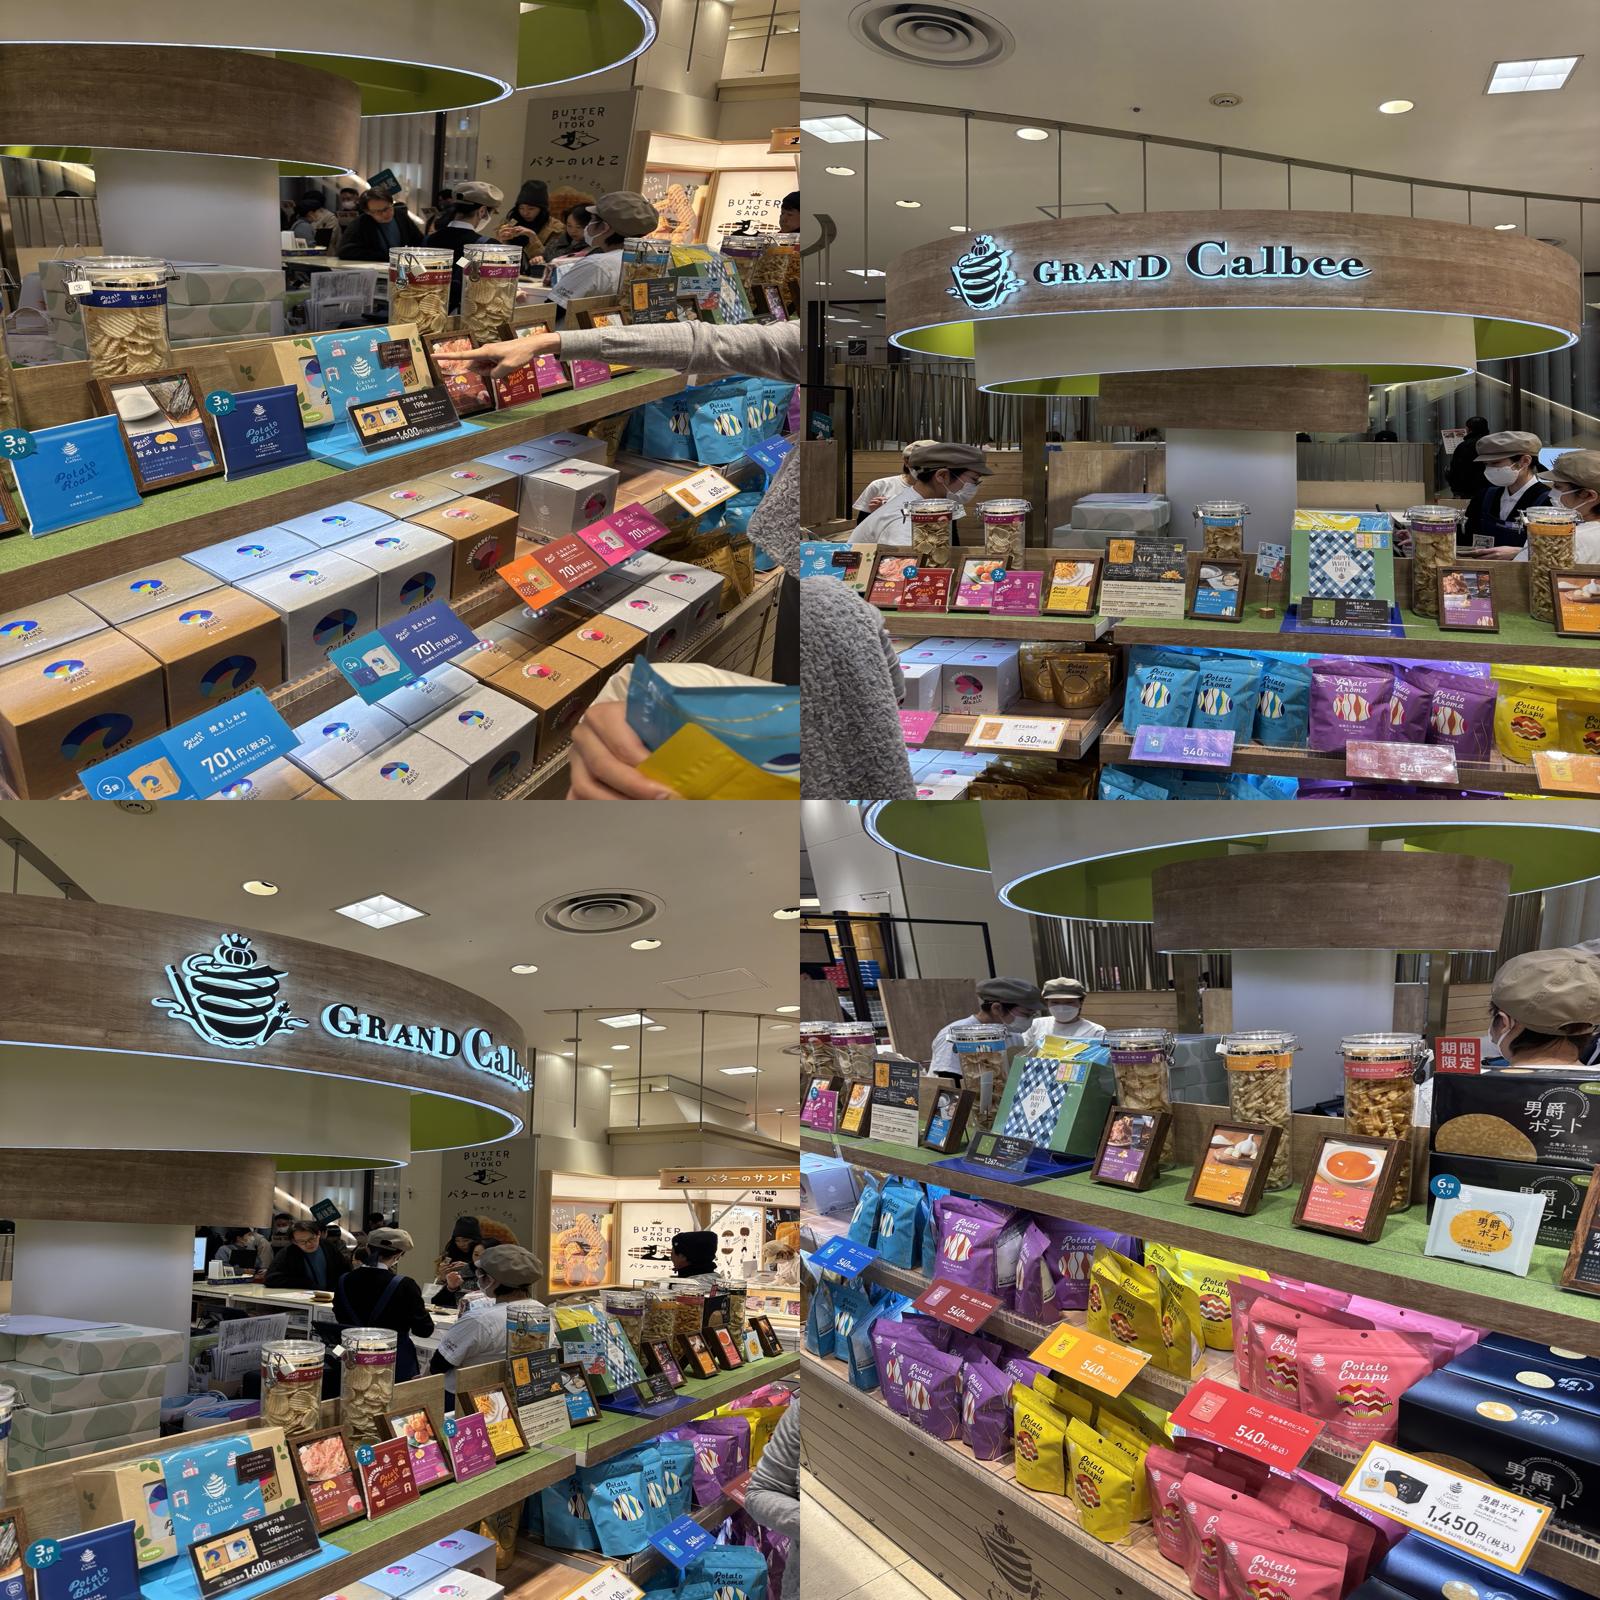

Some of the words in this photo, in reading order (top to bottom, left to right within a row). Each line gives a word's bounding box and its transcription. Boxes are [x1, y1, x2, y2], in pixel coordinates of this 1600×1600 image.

[552, 107, 605, 119] BUTTER
[558, 120, 595, 129] ITOKO
[530, 155, 619, 167] バターのいとこ
[728, 199, 781, 208] BUTTER
[1033, 254, 1171, 286] GRAND
[1186, 240, 1374, 281] Calbee
[709, 401, 731, 409] Potato
[246, 421, 278, 438] Potato
[250, 428, 280, 445] Basic
[54, 461, 96, 484] Potato
[1146, 673, 1173, 683] Aroma
[1151, 667, 1177, 677] Potato
[1204, 673, 1233, 683] Potato
[1202, 679, 1232, 689] Aroma
[1262, 675, 1286, 687] Potato
[1336, 677, 1369, 687] Potato
[1435, 690, 1465, 702] Potato
[1432, 697, 1464, 709] Aroma
[1515, 701, 1545, 712] Potato
[1513, 707, 1545, 719] Crispy
[209, 711, 248, 733] 焼きしお味
[201, 734, 272, 774] 701円(税込)
[321, 1003, 461, 1059] GRAND
[463, 1027, 534, 1092] Calbee
[1440, 1041, 1475, 1056] 期間
[1441, 1056, 1475, 1070] 限定
[1524, 1101, 1567, 1120] 男爵
[1529, 1118, 1582, 1138] ポテト
[464, 1150, 510, 1160] BUTTER
[704, 1173, 792, 1183] バターのサンド
[448, 1189, 527, 1200] バターのいとこ
[1543, 1205, 1573, 1222] テト
[633, 1226, 681, 1235] BUTTER
[952, 1224, 977, 1237] Aroma
[956, 1218, 980, 1230] Potato
[1477, 1217, 1502, 1231] 男爵
[1478, 1229, 1511, 1241] ポテト
[1203, 1277, 1229, 1288] Potat
[1200, 1283, 1231, 1297] Crispy
[1117, 1295, 1136, 1311] Potato
[1113, 1301, 1135, 1319] Crispy
[1275, 1334, 1297, 1347] Pot
[910, 1363, 933, 1378] Potato
[1341, 1360, 1389, 1372] Potato
[908, 1370, 932, 1385] Aroma
[1339, 1370, 1390, 1383] Crispy
[1560, 1378, 1578, 1387] 男爵
[1558, 1382, 1586, 1392] ポテト
[1520, 1415, 1550, 1426] ポテト
[1522, 1409, 1545, 1419] 男爵
[1020, 1419, 1041, 1439] Crispy
[1023, 1414, 1043, 1432] Potato
[1235, 1424, 1289, 1456] 540円(税込)
[1080, 1455, 1105, 1476] Potato
[1078, 1462, 1104, 1484] Crispy
[1505, 1461, 1555, 1491] 男爵
[606, 1480, 628, 1490] Potato
[609, 1486, 632, 1495] Aroma
[206, 1502, 234, 1516] Calbee
[1480, 1494, 1526, 1517] 男爵ポテト
[1477, 1503, 1518, 1523] 北海道バター味
[1426, 1505, 1516, 1554] 1,450円(税込)
[1252, 1555, 1297, 1575] Potato
[69, 1567, 108, 1592] Potato
[713, 1577, 744, 1586] Aroma
[714, 1571, 743, 1580] Potato
[73, 1576, 110, 1600] Basic
